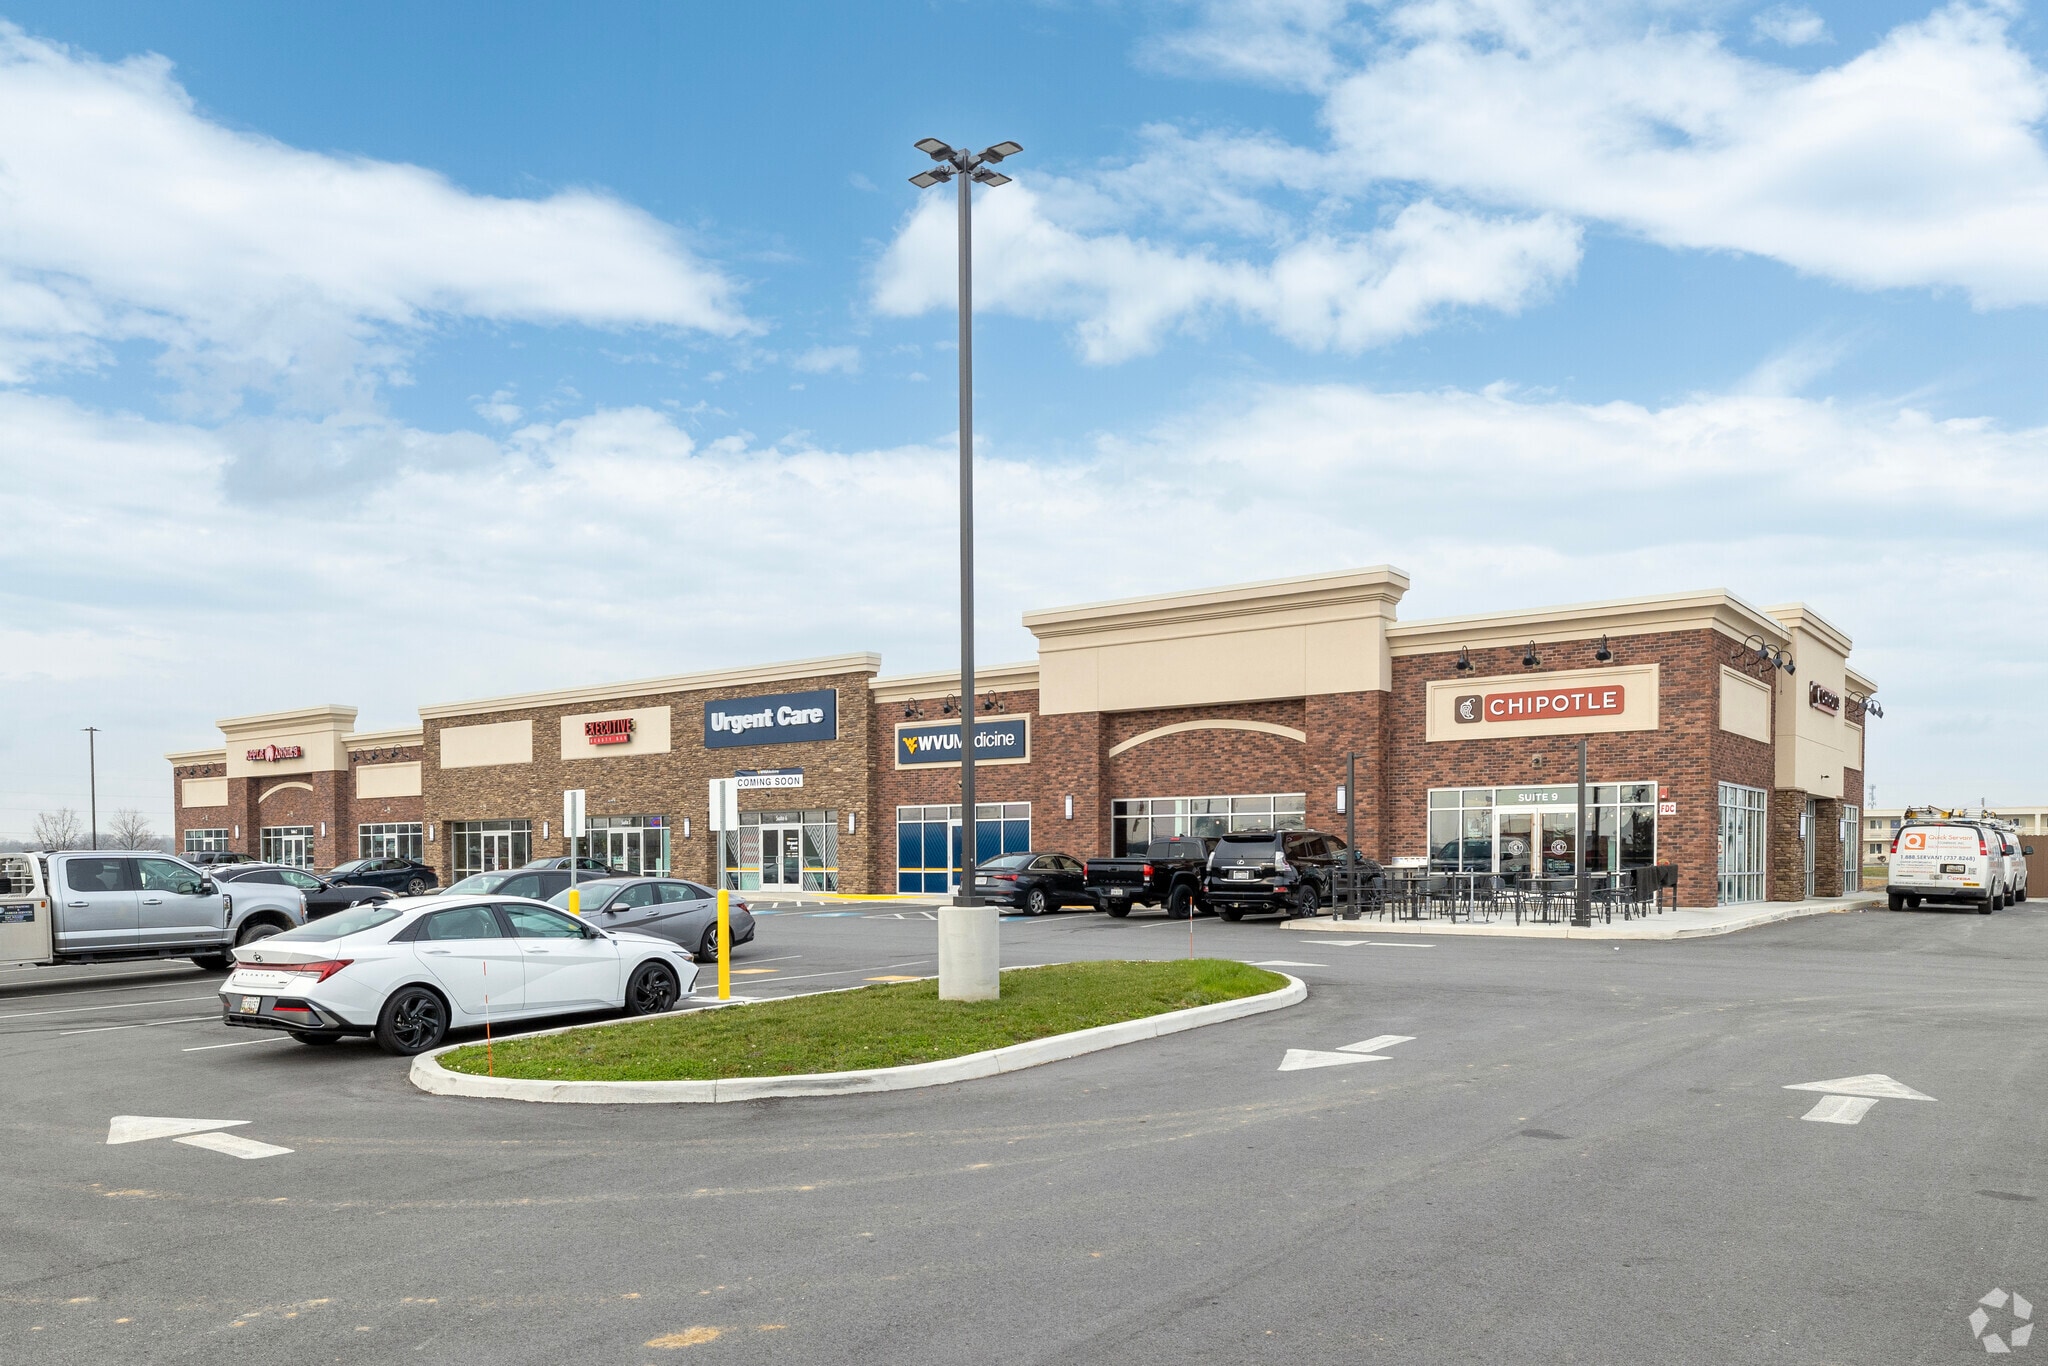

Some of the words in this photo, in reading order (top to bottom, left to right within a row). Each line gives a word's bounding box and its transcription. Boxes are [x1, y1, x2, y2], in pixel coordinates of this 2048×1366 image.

[1489, 691, 1617, 716] CHIPOTLE
[584, 717, 633, 736] EXECUTIVE
[711, 708, 774, 734] Urgent
[776, 706, 824, 726] Care
[918, 730, 1015, 751] WVUMdicine
[737, 777, 771, 787] COMING
[775, 777, 800, 786] SOON
[1518, 793, 1548, 802] SUITE
[1551, 792, 1558, 801] 9
[1660, 804, 1676, 813] FDC
